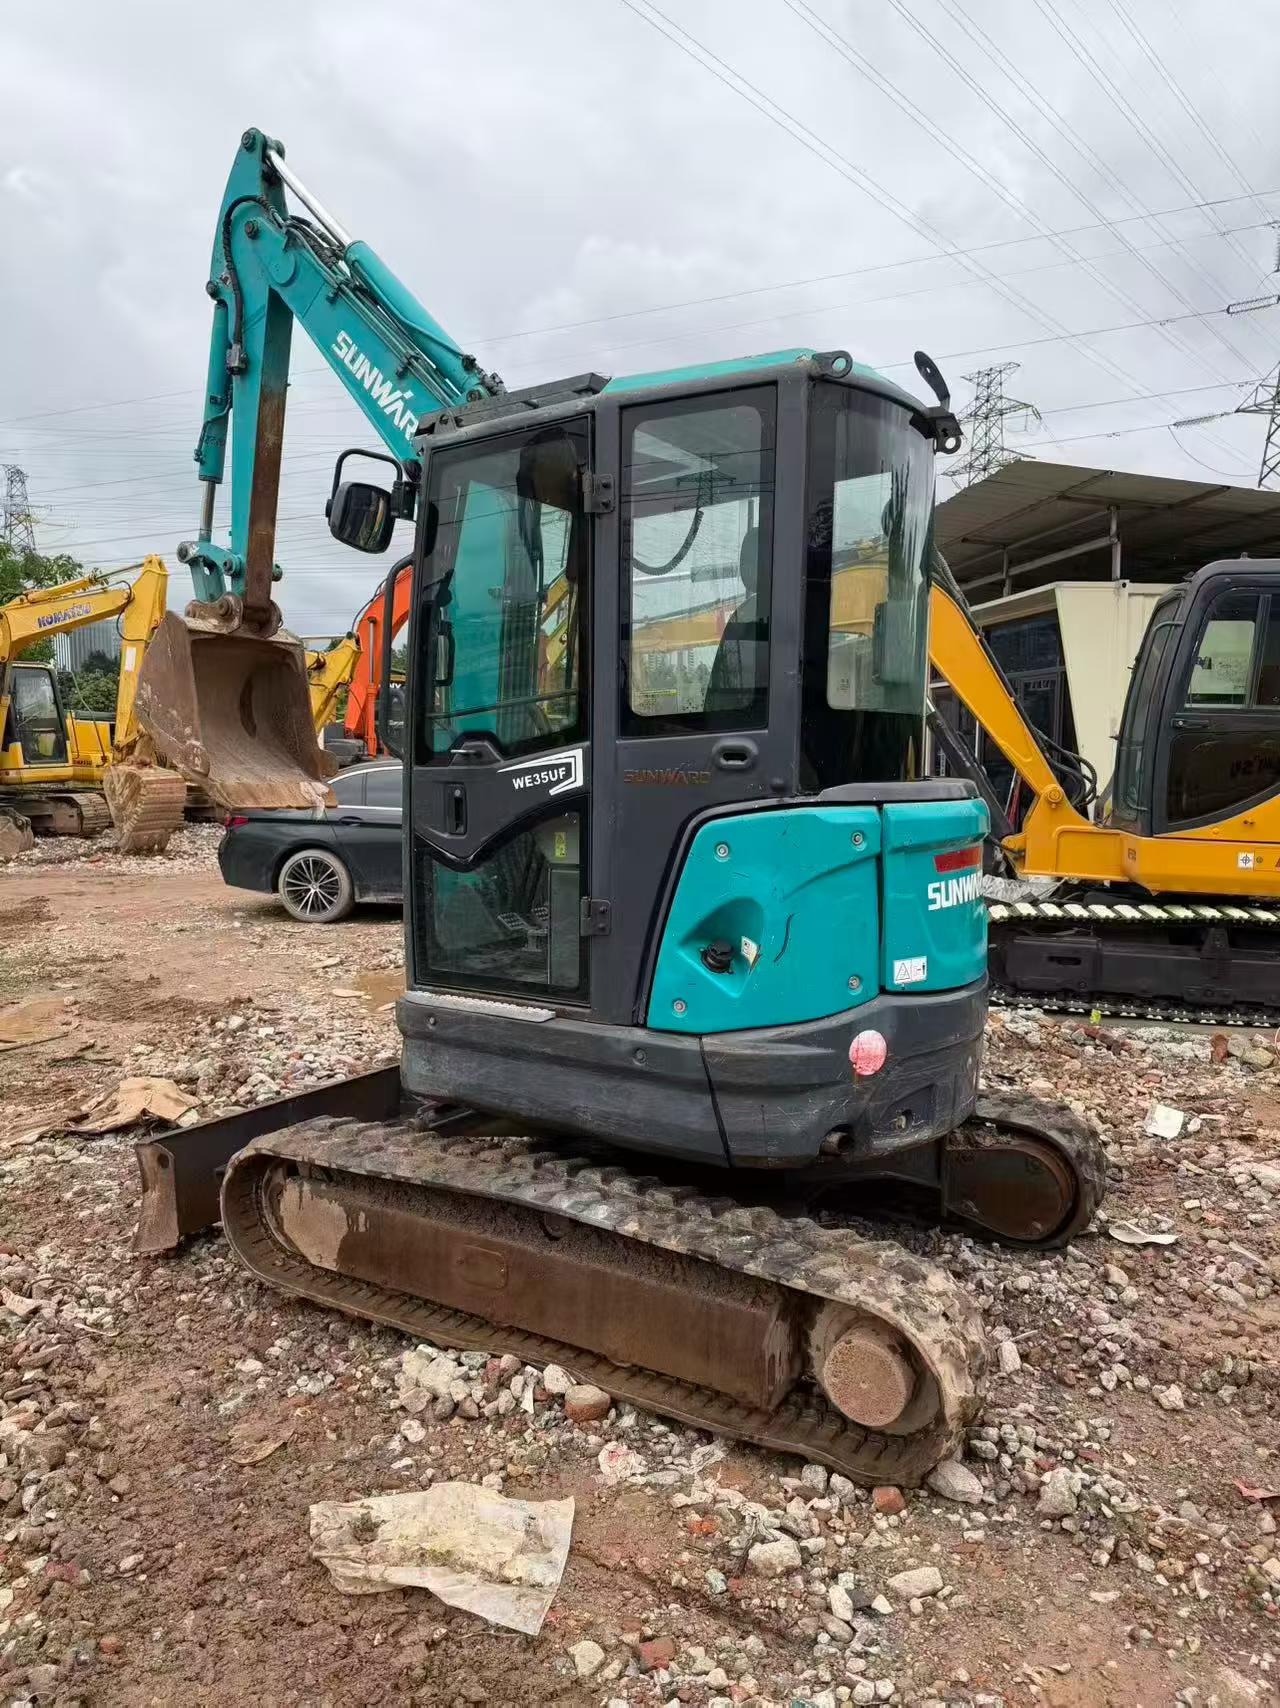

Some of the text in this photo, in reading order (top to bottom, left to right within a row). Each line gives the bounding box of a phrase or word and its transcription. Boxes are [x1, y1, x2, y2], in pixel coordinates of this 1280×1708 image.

[331, 330, 420, 441] SUNWAR
[512, 767, 566, 790] WE35UF
[927, 871, 982, 911] SUNWA
